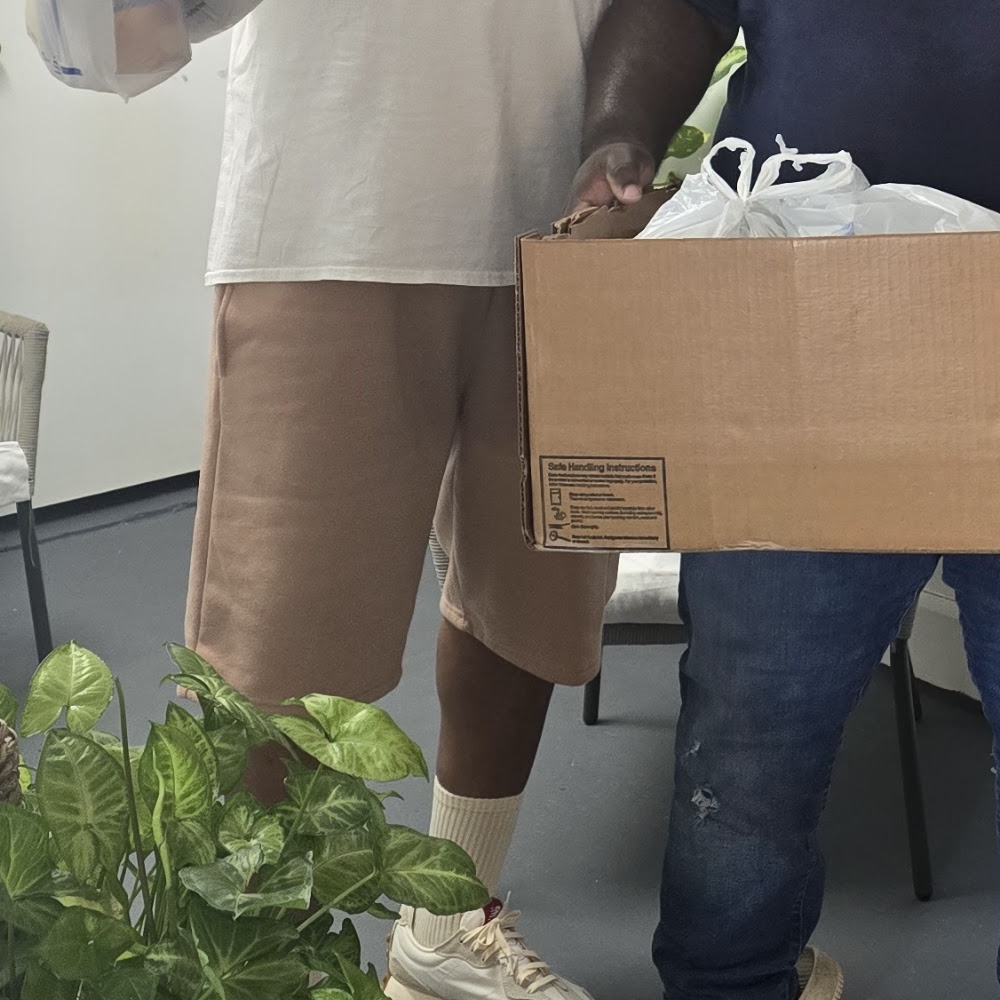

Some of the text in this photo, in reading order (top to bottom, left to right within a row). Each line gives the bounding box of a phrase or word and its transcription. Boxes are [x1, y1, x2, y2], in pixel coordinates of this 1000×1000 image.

[548, 462, 657, 473] Safe Handling Instructions
